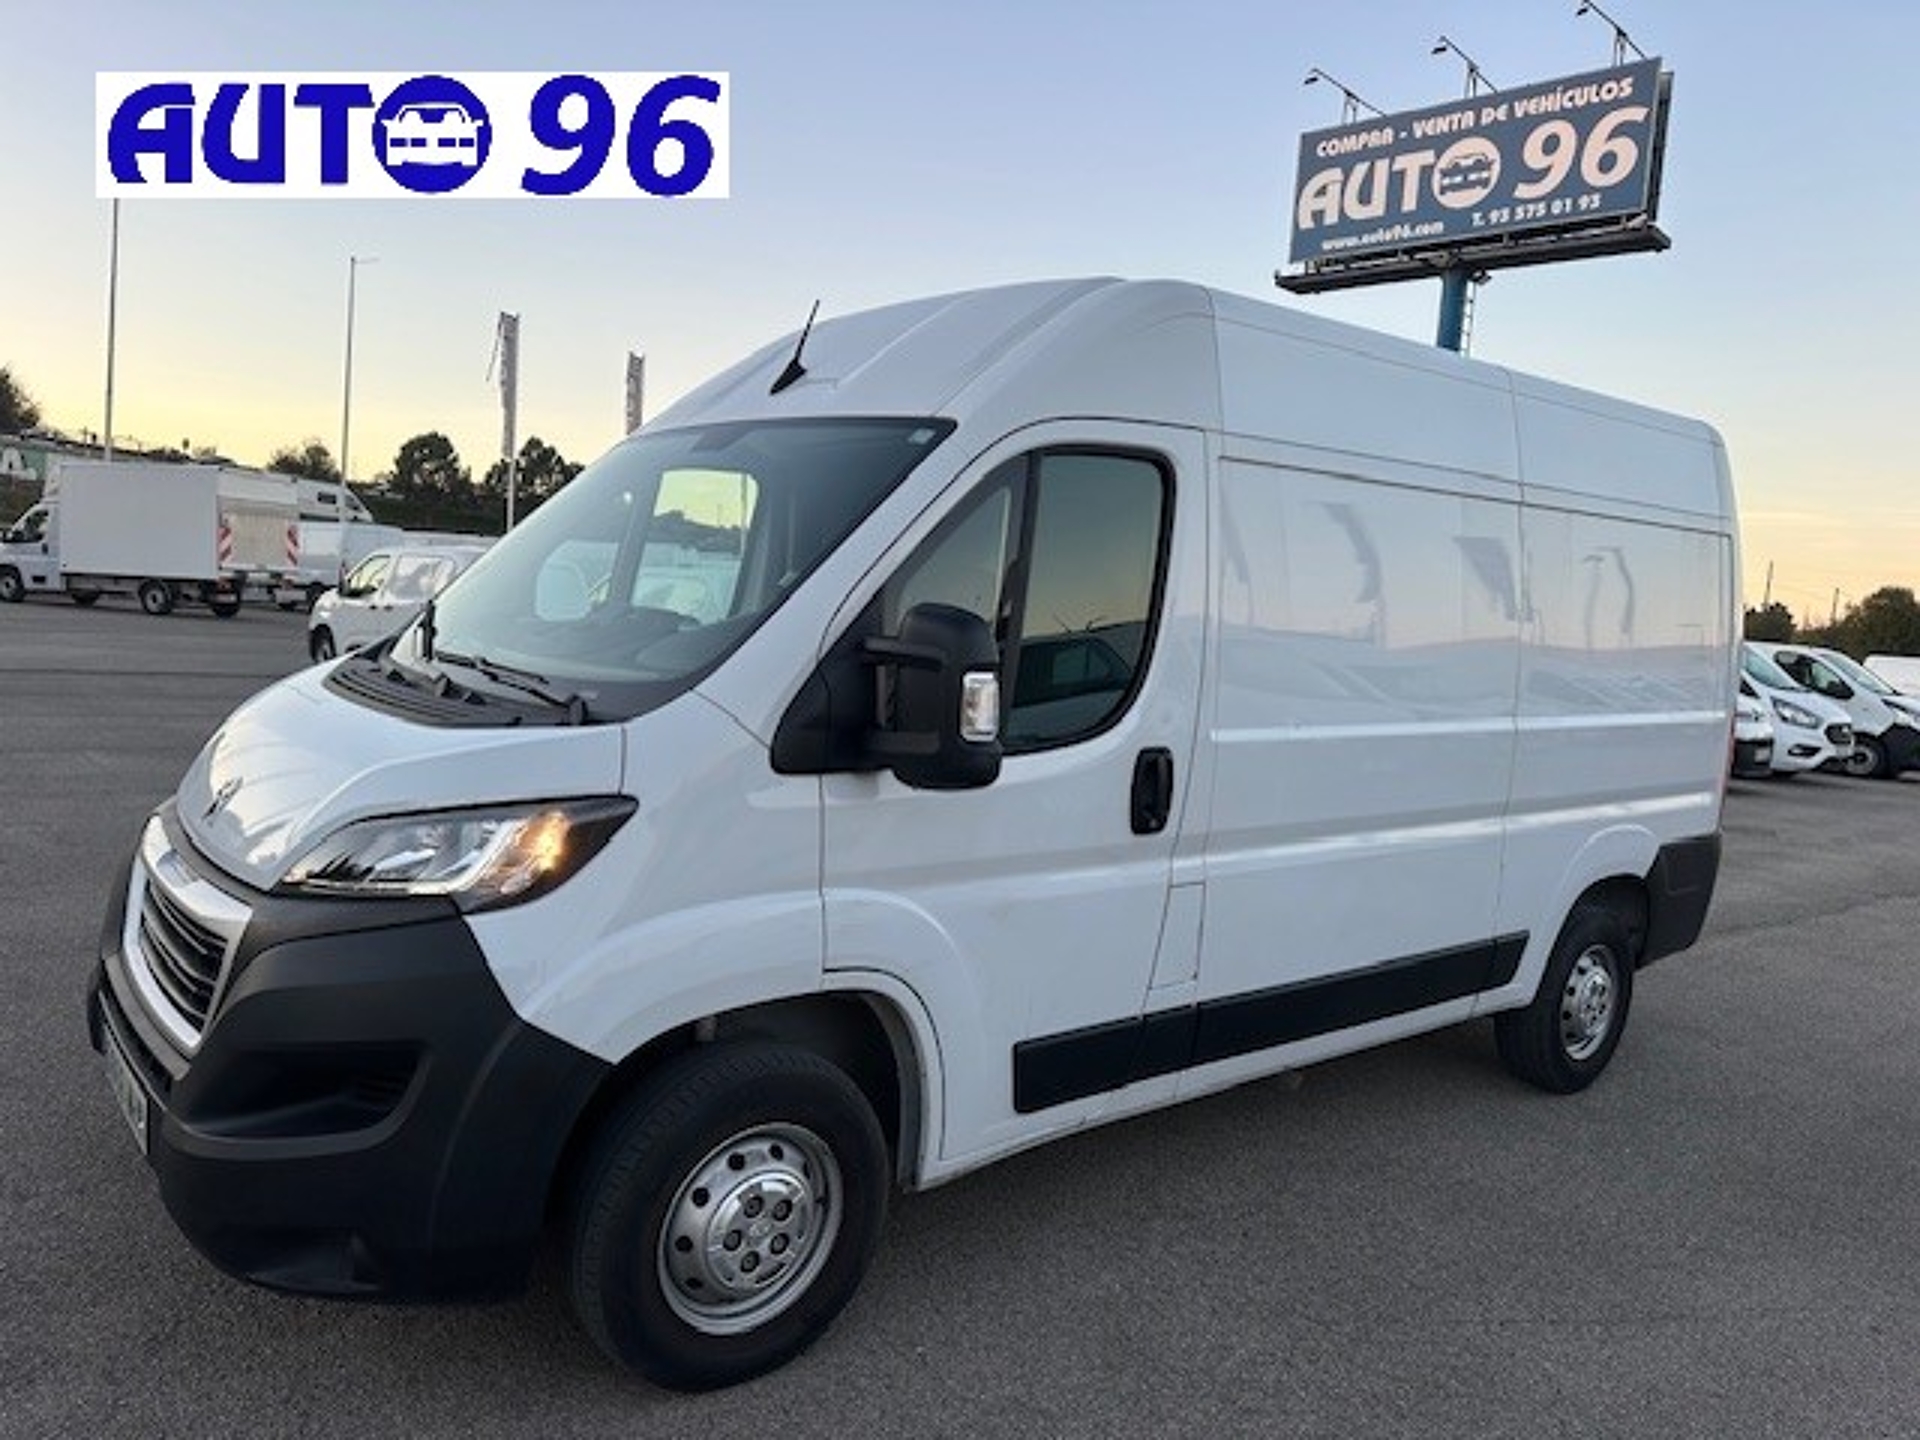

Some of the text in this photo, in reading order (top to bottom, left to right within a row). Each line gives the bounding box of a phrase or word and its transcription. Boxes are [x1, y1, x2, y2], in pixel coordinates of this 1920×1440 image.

[1298, 106, 1650, 229] AUTO 96
[1316, 126, 1395, 157] COMPRA
[1412, 109, 1475, 139] VENTA
[1480, 103, 1510, 126] DE
[1514, 77, 1635, 118] VEHÍCULOS
